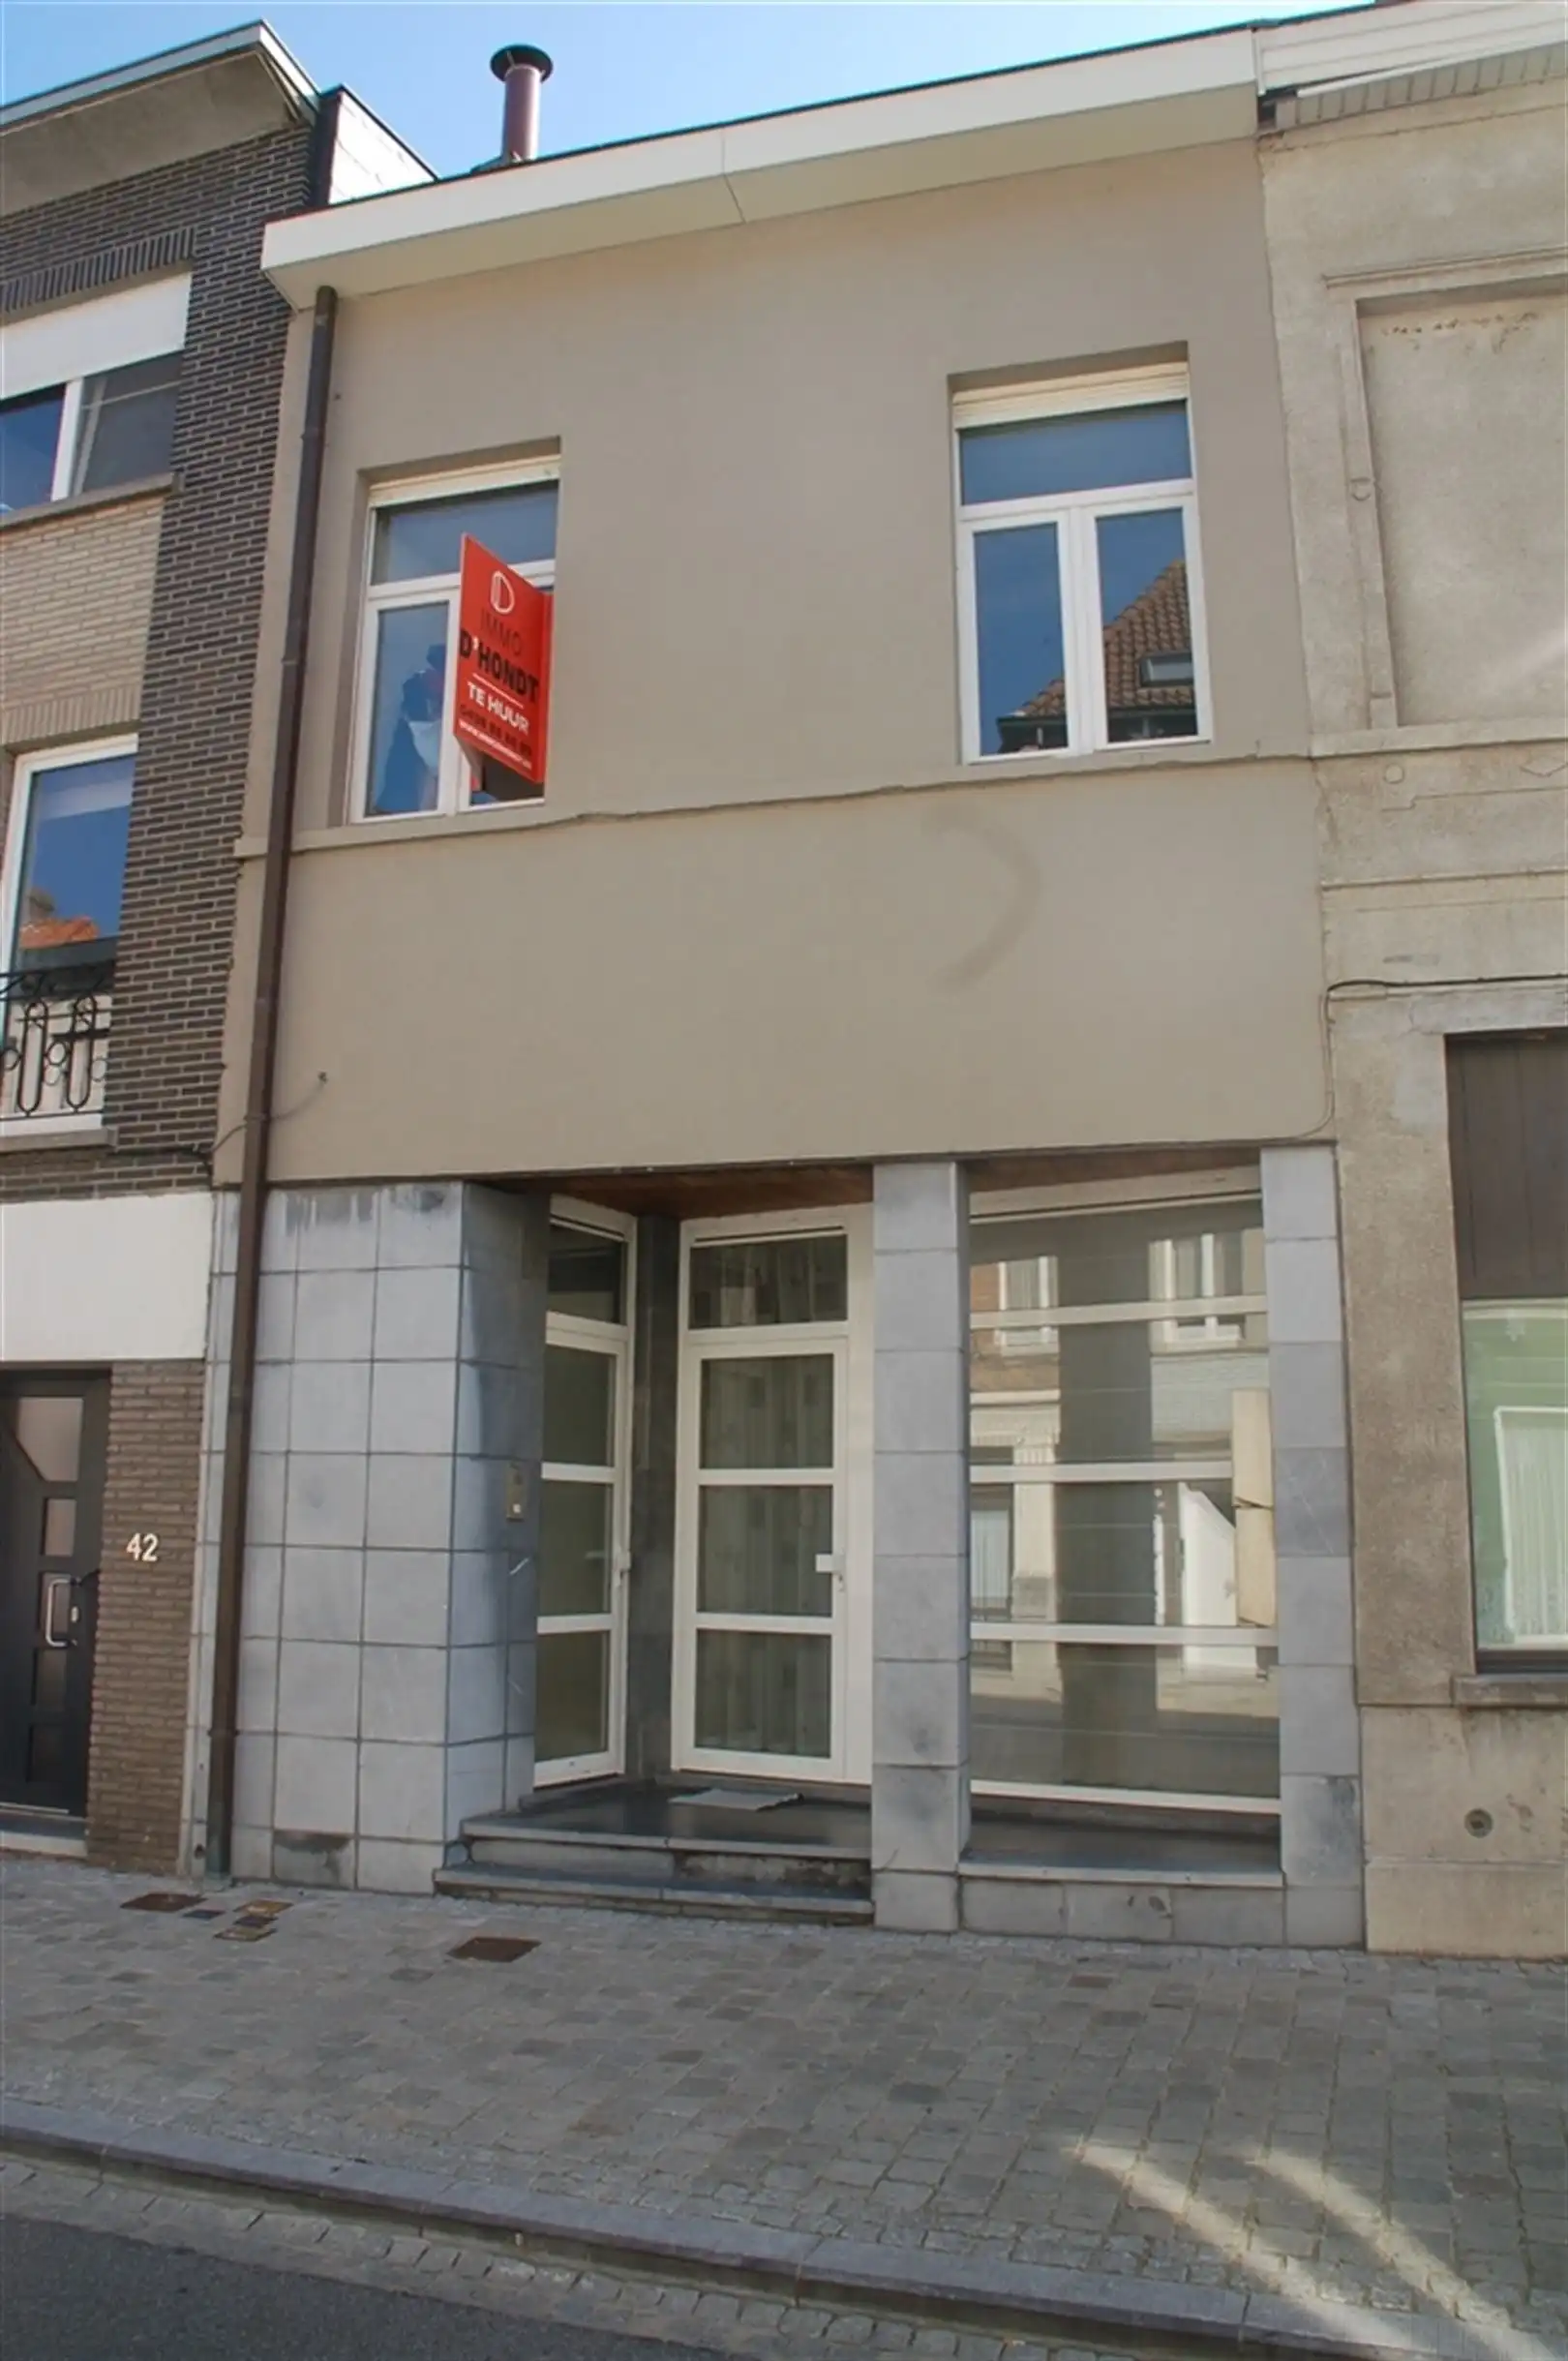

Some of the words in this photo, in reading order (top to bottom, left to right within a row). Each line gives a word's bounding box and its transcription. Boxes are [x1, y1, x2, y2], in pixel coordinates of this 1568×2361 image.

[480, 607, 523, 658] IMMO
[459, 627, 540, 705] D'HONDT
[467, 681, 486, 708] TE
[487, 693, 529, 736] HUUR
[126, 1532, 158, 1561] 42
